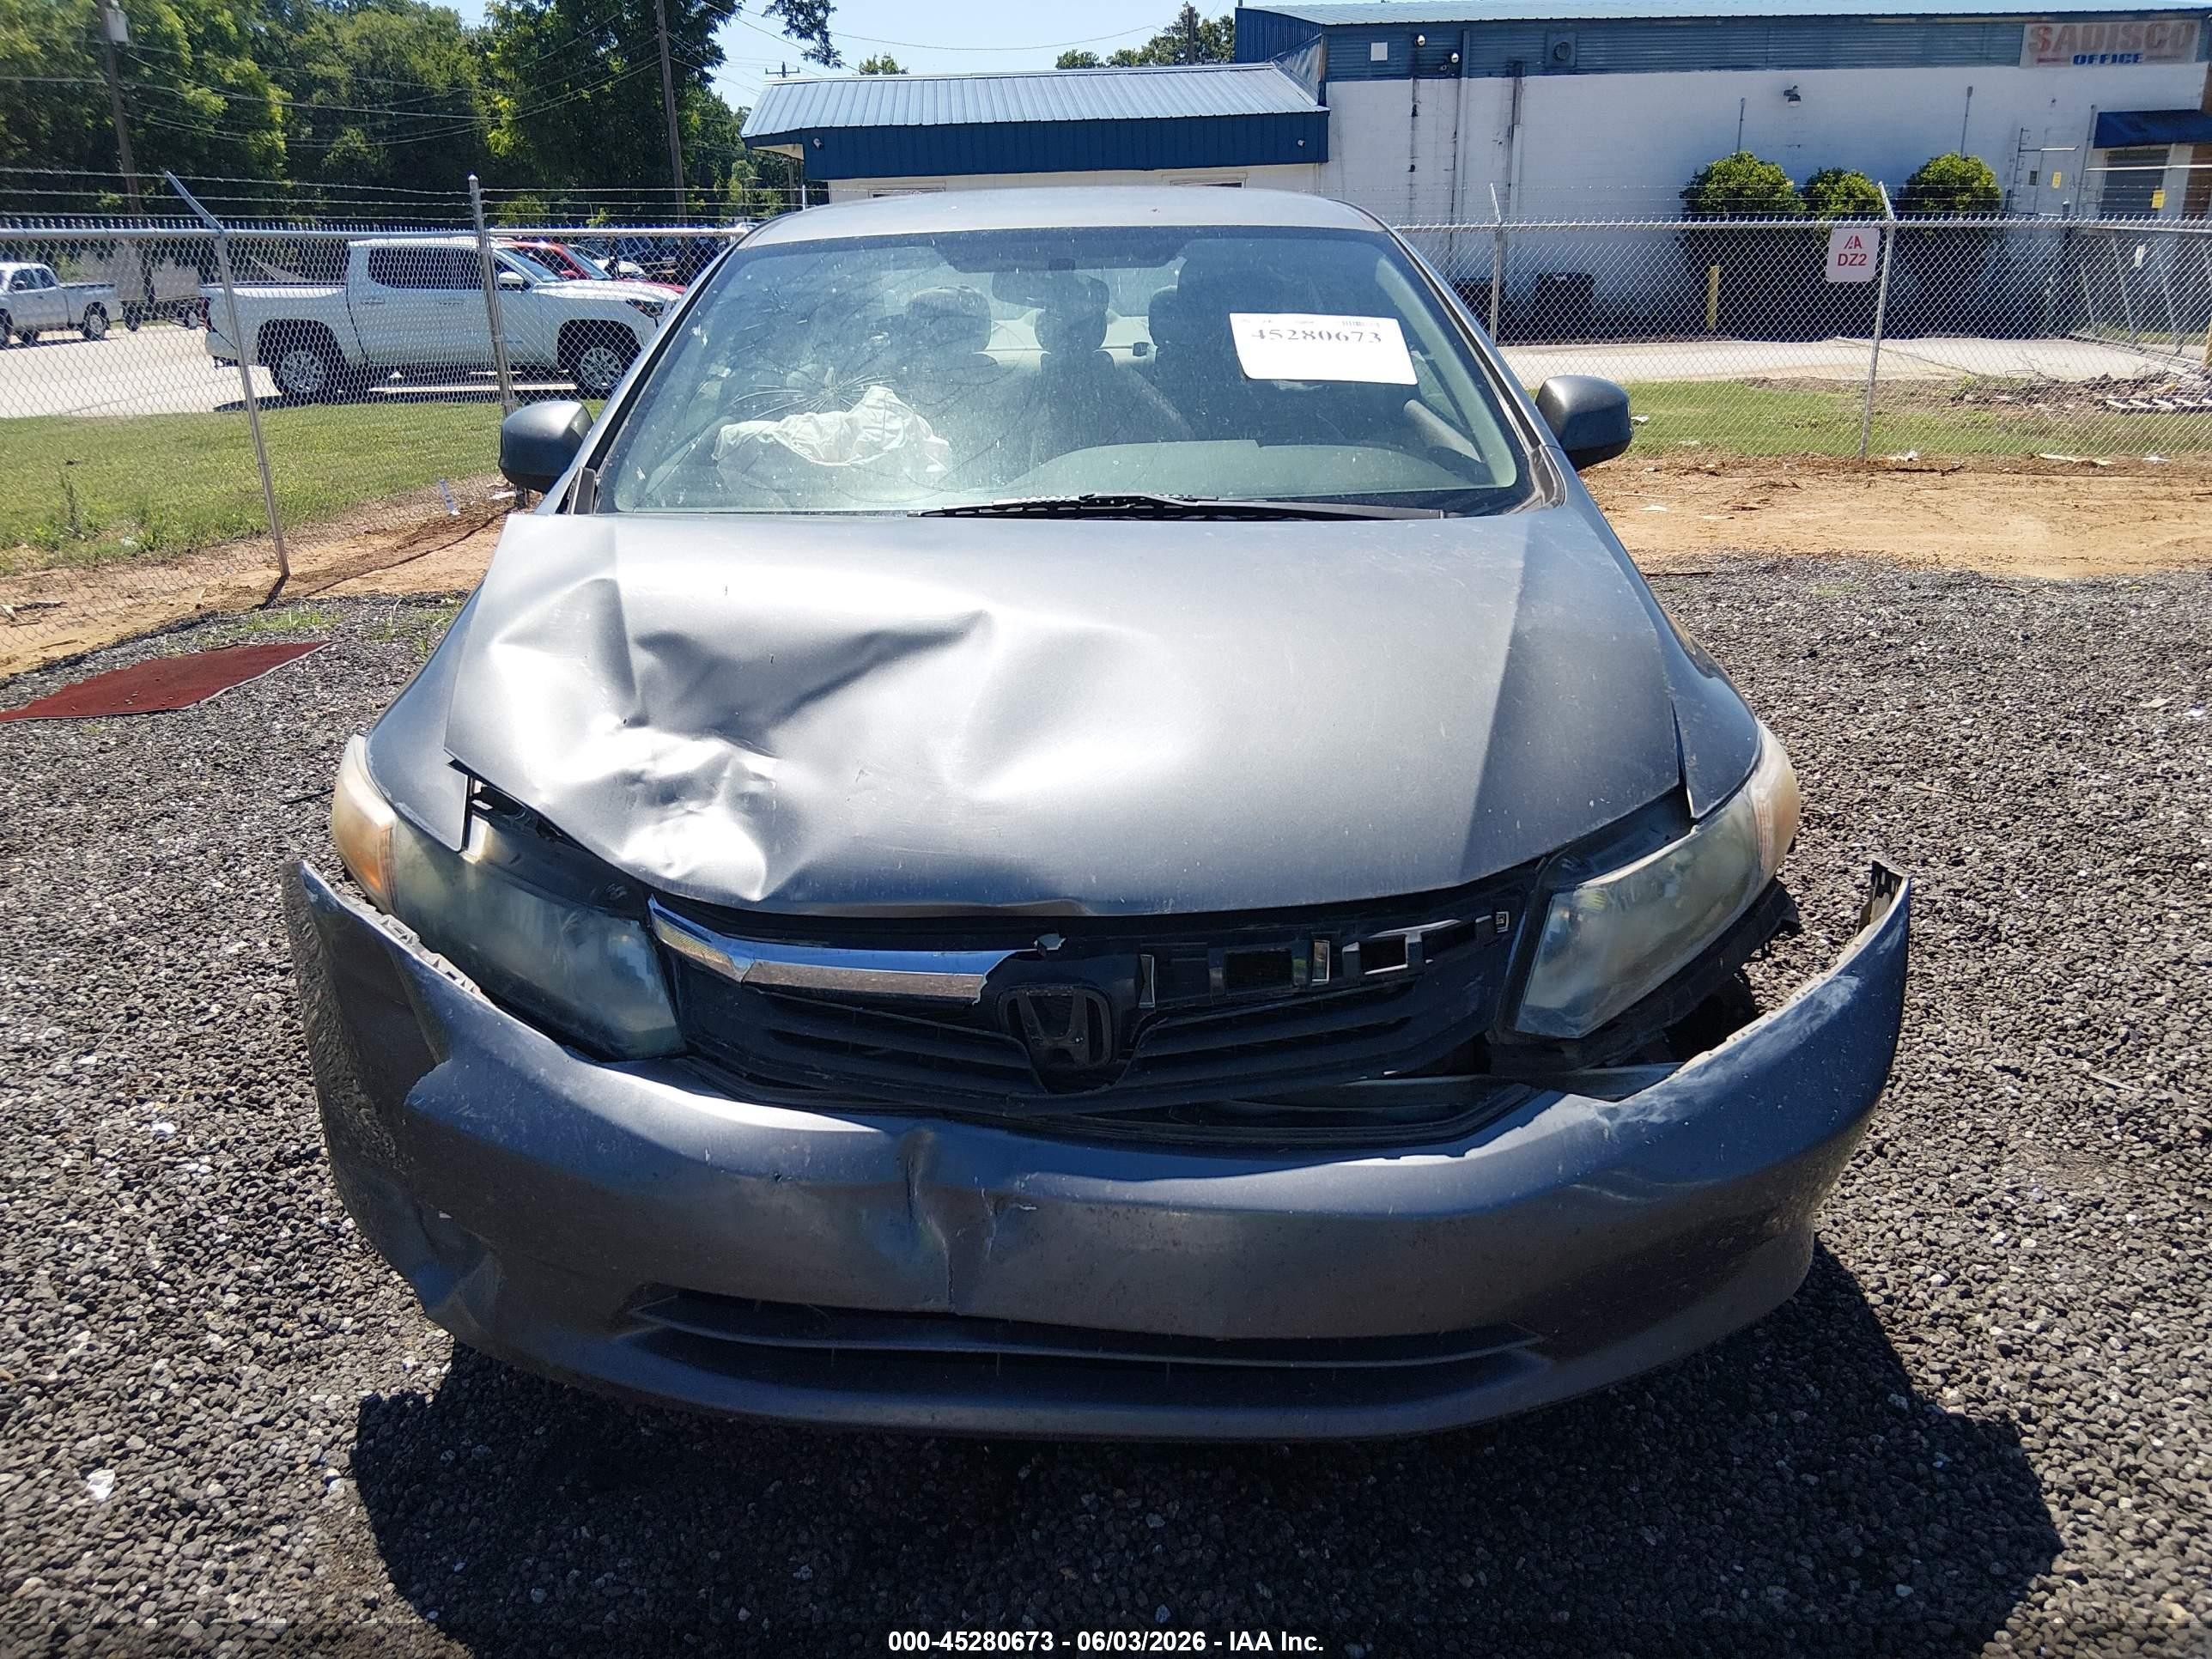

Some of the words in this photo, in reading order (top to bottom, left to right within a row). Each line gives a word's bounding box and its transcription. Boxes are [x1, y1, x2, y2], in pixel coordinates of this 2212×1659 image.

[2027, 21, 2197, 54] SADISCO
[2072, 52, 2144, 65] OFFICE
[1837, 253, 1868, 266] DZ2
[1252, 329, 1382, 343] 45280673
